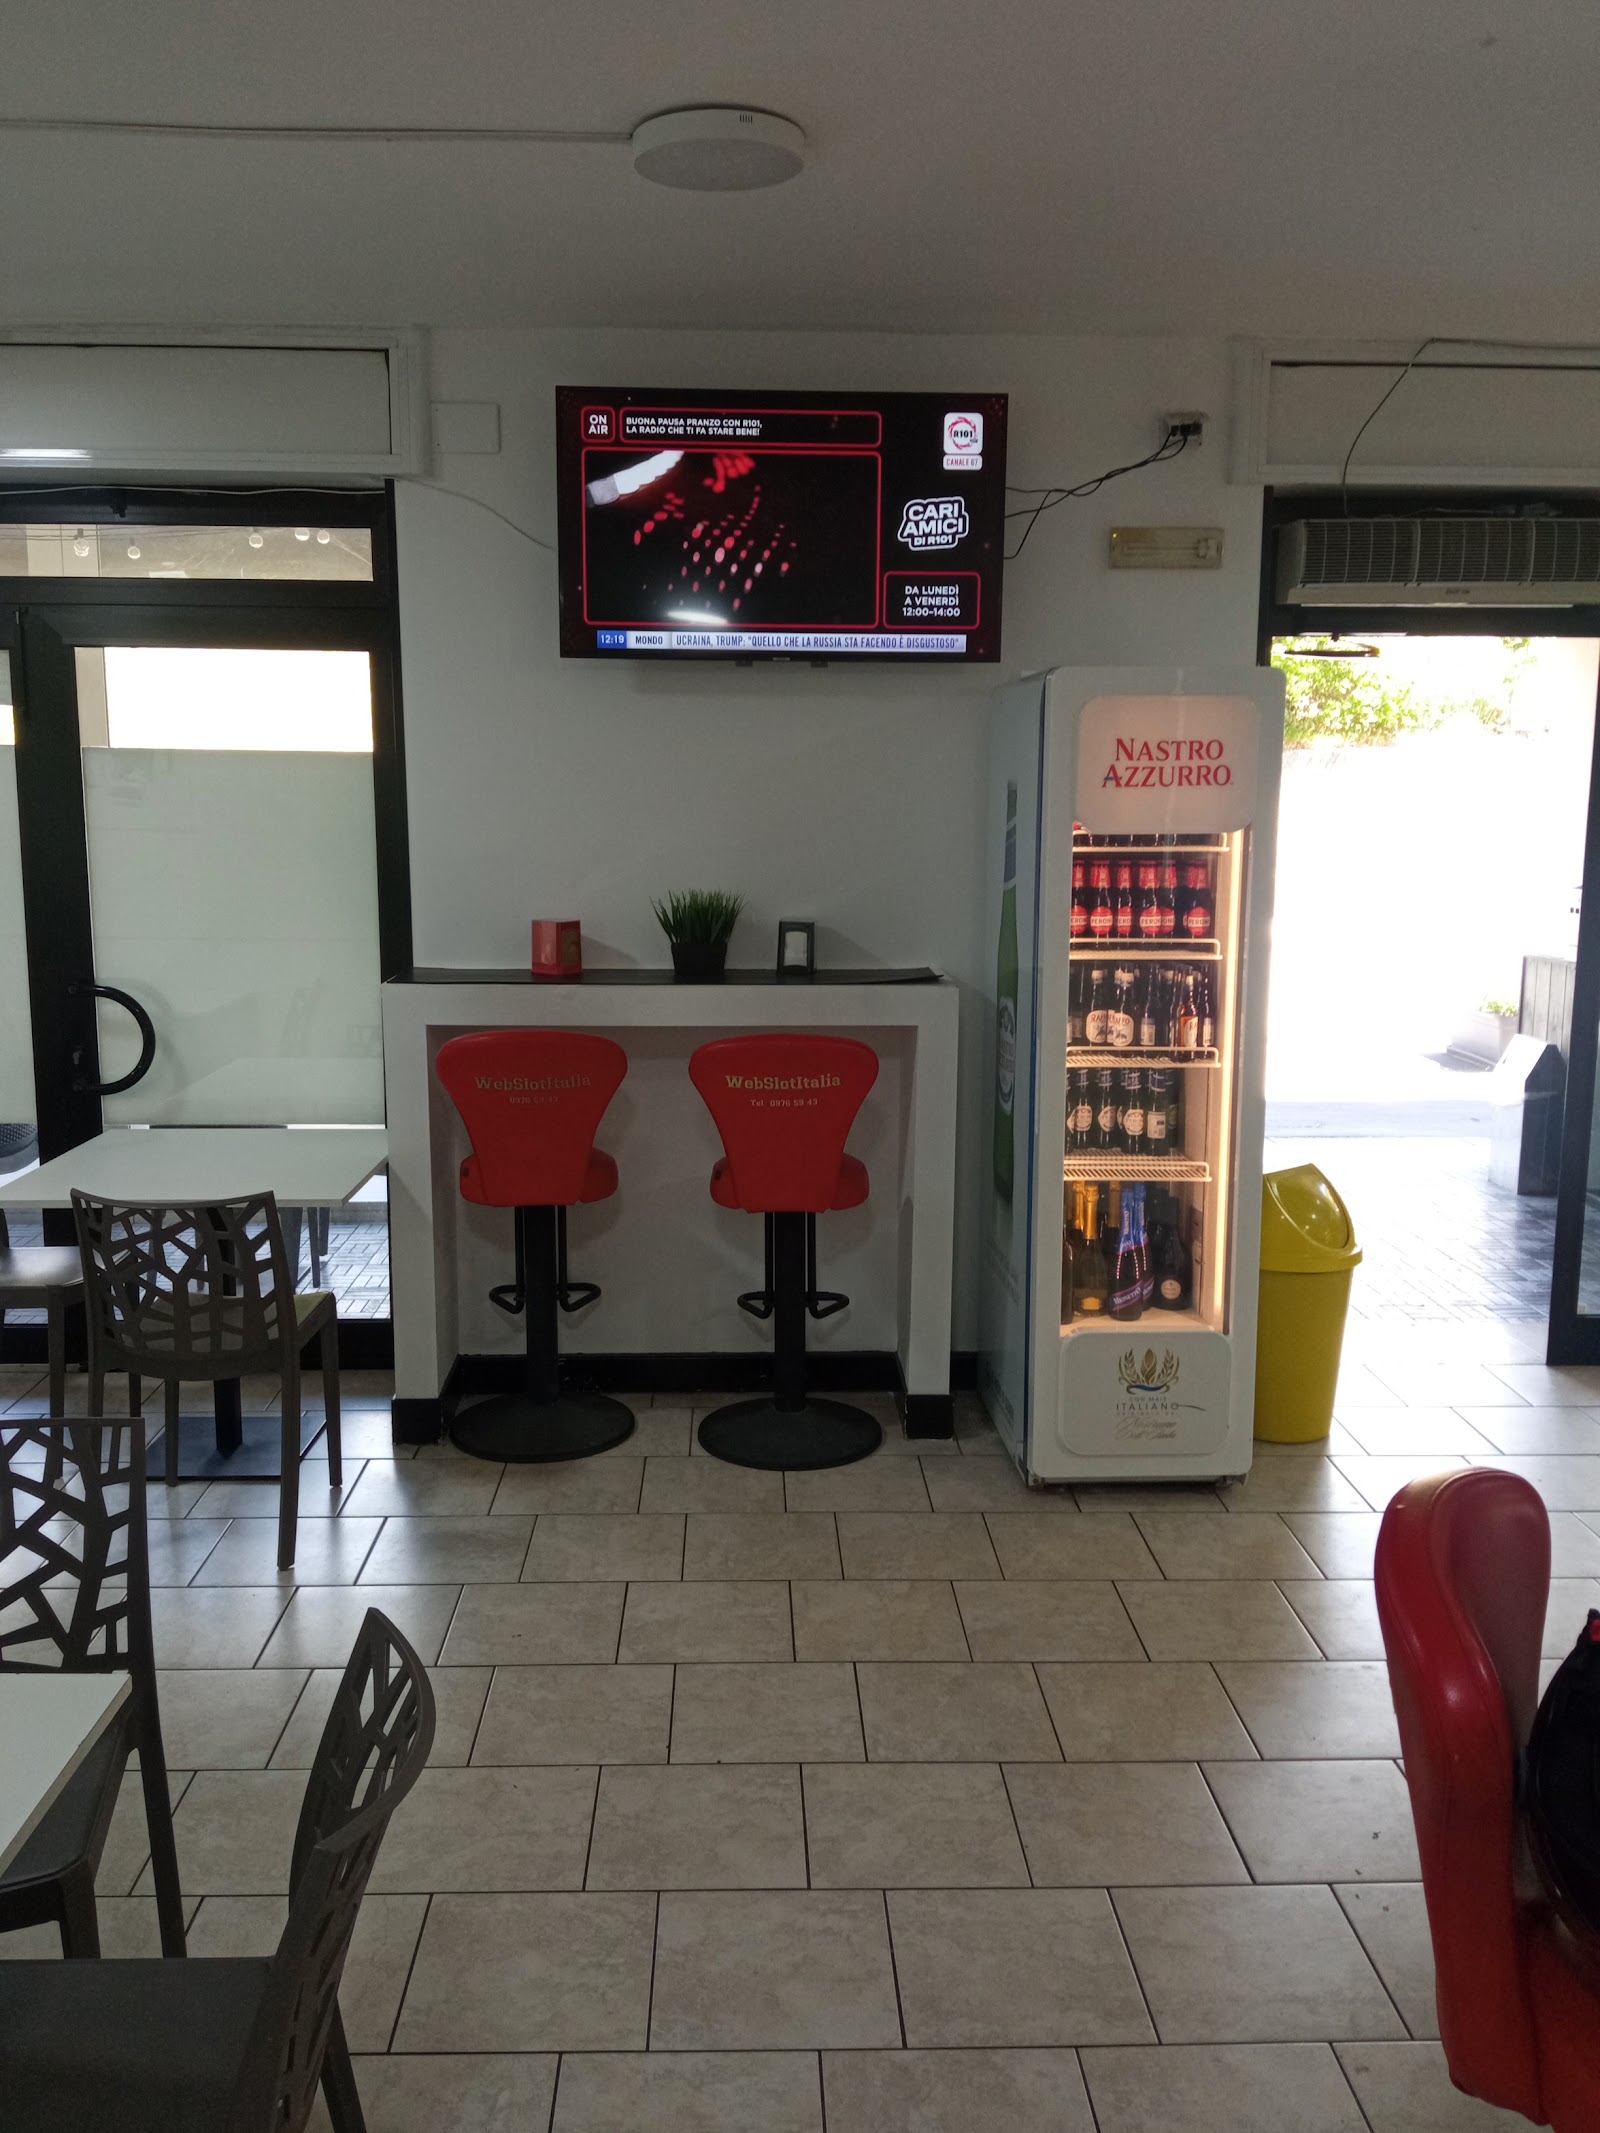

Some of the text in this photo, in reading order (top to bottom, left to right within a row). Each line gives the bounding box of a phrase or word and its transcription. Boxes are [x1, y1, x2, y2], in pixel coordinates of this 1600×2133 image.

[589, 414, 607, 424] ON
[626, 417, 762, 428] BUONA PAUSA PRANZO CON R101,
[588, 424, 608, 434] AIR
[626, 425, 760, 436] LA RADIO CHE TI FA STARE BENE!
[954, 430, 973, 438] R101
[947, 458, 969, 466] CANALE
[909, 503, 959, 521] CARI
[903, 518, 963, 537] AMICI
[914, 535, 952, 546] DI R101
[905, 584, 959, 595] DA LUNEDÌ
[904, 595, 959, 606] A VENERDÌ
[902, 607, 961, 617] 12:00-14:00
[600, 634, 625, 644] 12:19
[635, 635, 663, 645] MONDO
[676, 635, 714, 647] UCRAINA,
[716, 635, 746, 647] TRUMP:
[748, 636, 782, 648] "QUELLO
[784, 636, 800, 647] CHE
[802, 636, 811, 647] LA
[813, 637, 842, 648] RUSSIA
[844, 637, 859, 648] STA
[861, 637, 896, 648] FACENDO
[906, 637, 959, 649] DISGUSTOSO"
[1115, 738, 1224, 761] NASTRO
[1102, 764, 1231, 788] AZZURRO
[474, 1073, 592, 1091] WebSlotItalia
[725, 1073, 841, 1090] WebSlotItalia
[750, 1099, 764, 1107] Tel
[1116, 1402, 1179, 1411] ITALIANO
